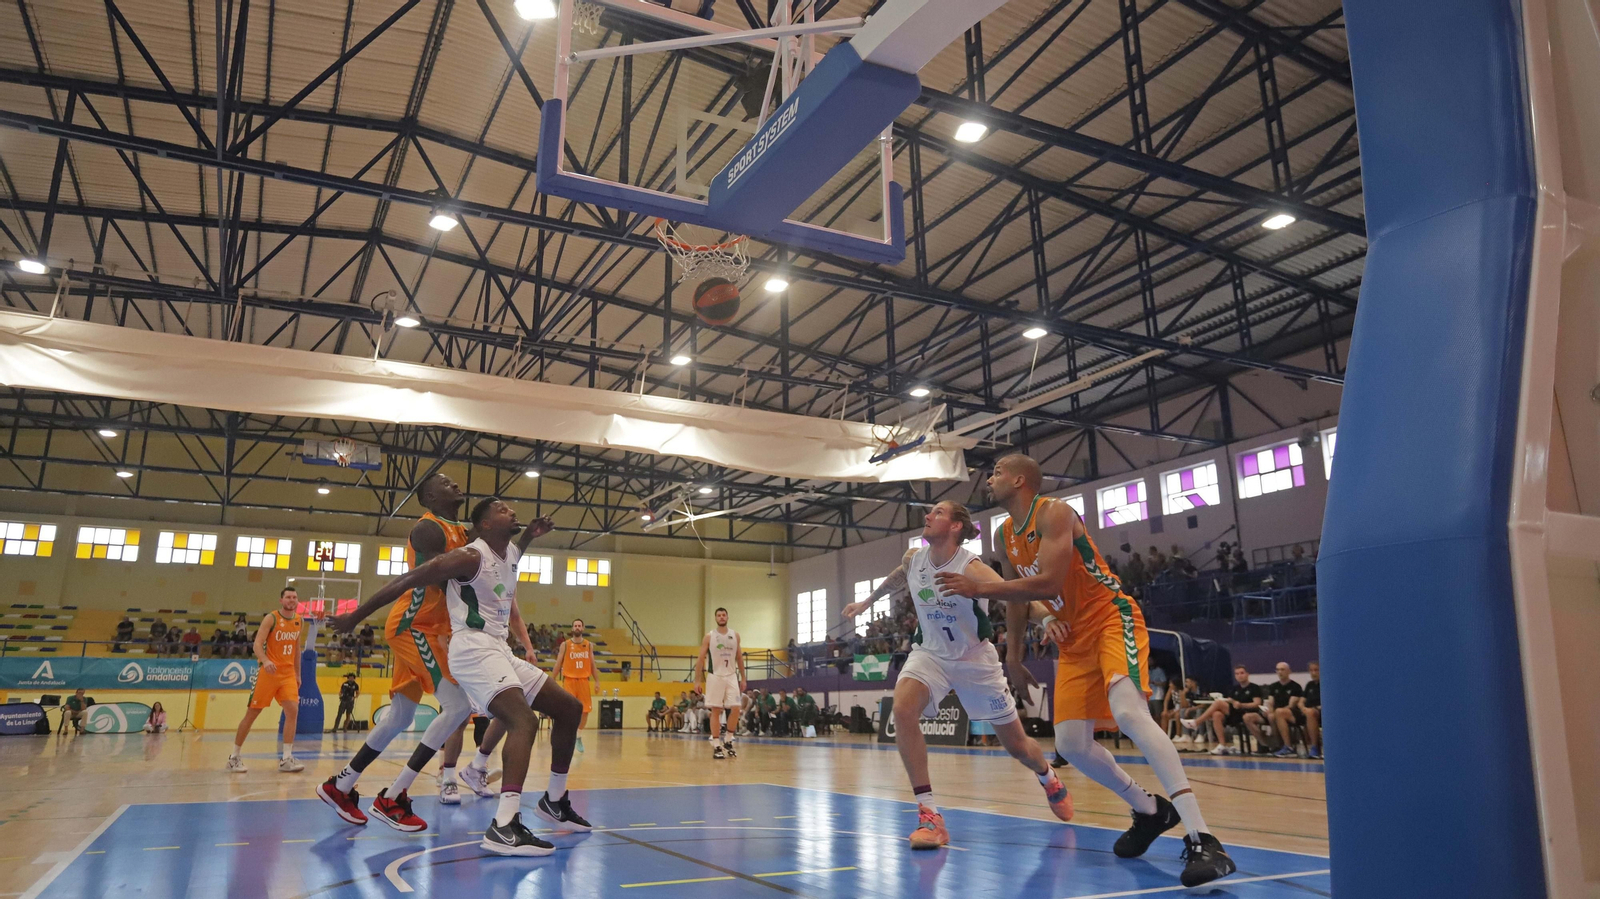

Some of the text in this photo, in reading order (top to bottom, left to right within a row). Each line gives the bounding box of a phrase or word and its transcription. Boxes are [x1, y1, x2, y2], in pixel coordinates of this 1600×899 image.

[727, 96, 800, 184] SPORTSYSTEM
[315, 547, 333, 561] 24
[282, 644, 293, 655] 13
[575, 660, 584, 669] 10
[147, 666, 192, 675] baloncesto
